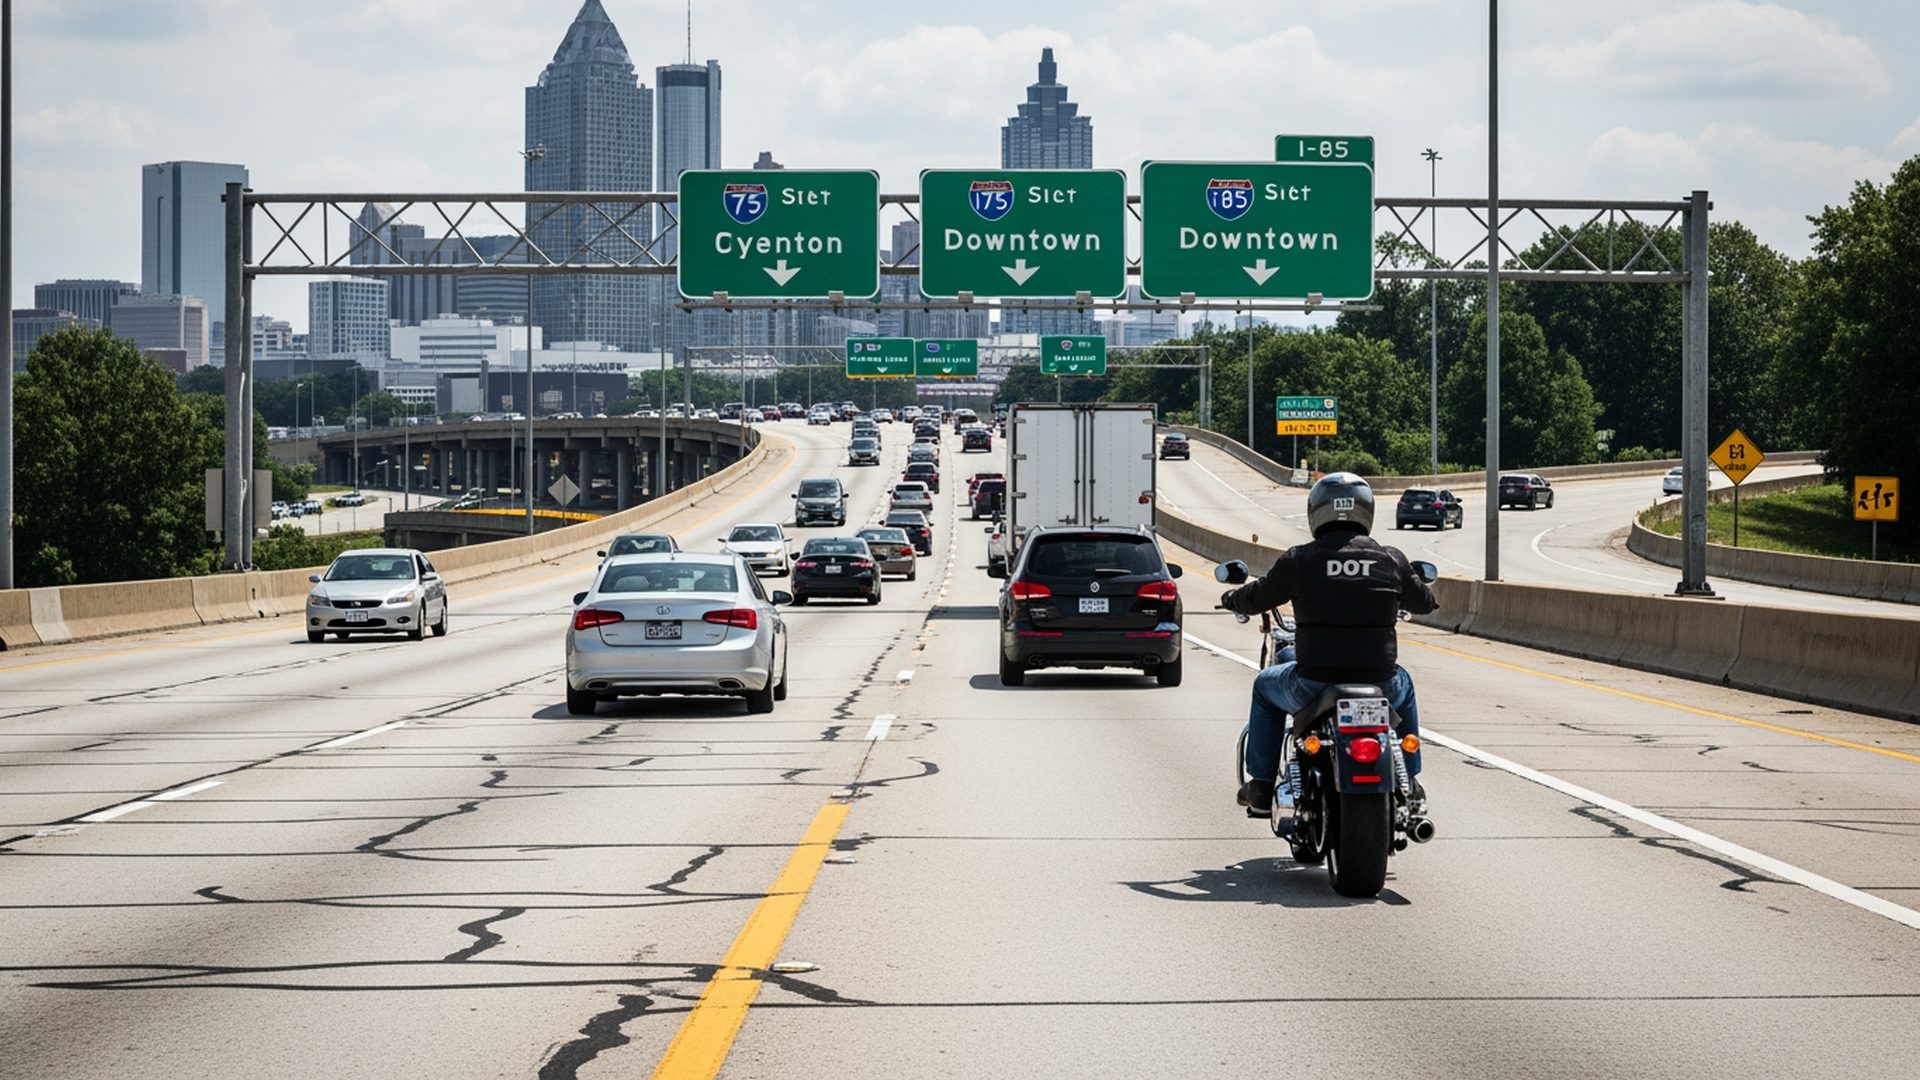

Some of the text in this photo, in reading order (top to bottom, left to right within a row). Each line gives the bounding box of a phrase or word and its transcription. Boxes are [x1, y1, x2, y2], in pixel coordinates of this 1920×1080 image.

[731, 194, 762, 216] 75
[944, 228, 1101, 251] Downtown
[1179, 227, 1338, 250] Downtown
[1326, 559, 1375, 577] DOT
